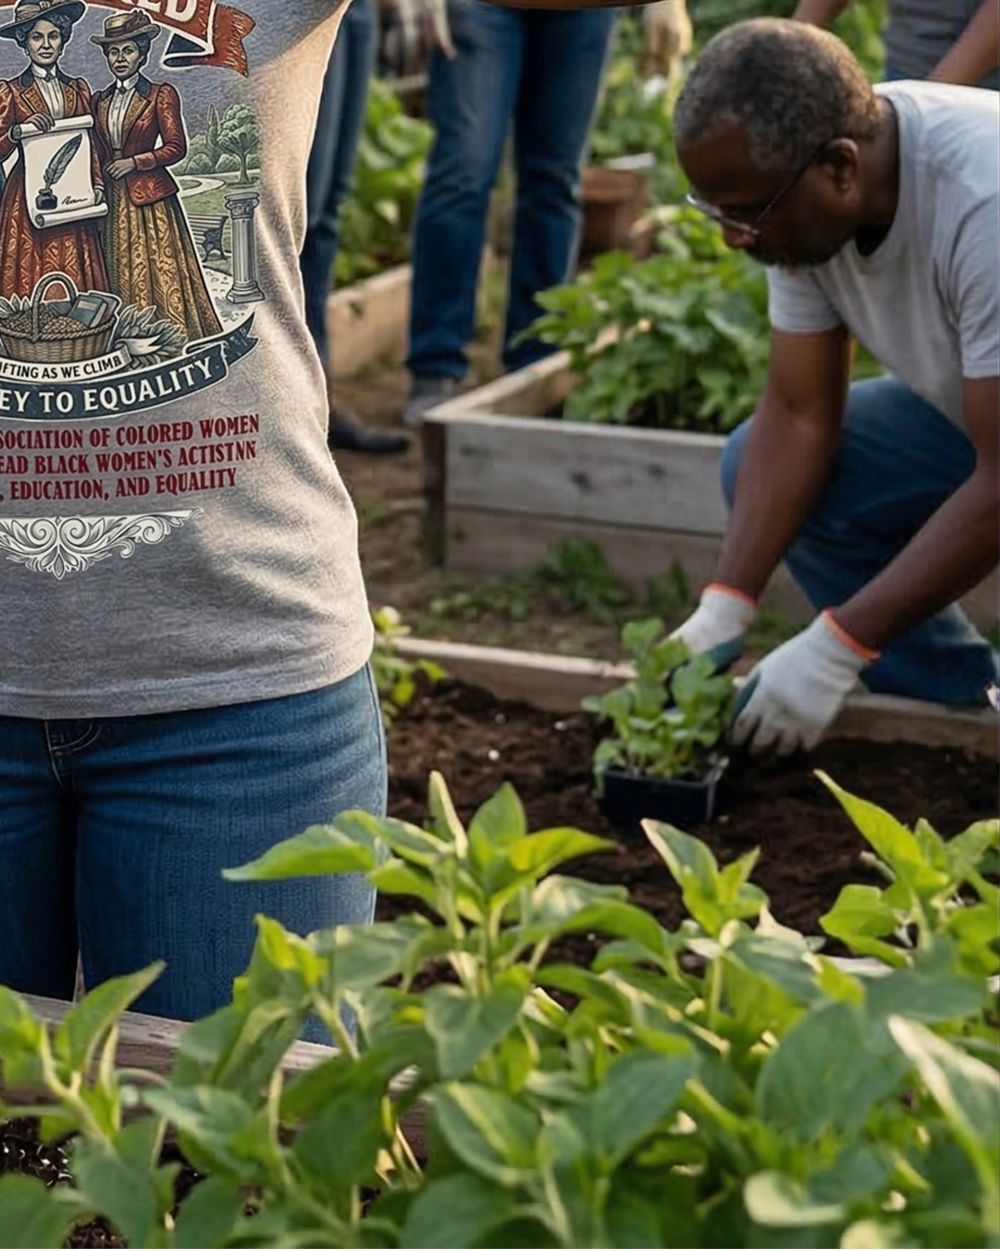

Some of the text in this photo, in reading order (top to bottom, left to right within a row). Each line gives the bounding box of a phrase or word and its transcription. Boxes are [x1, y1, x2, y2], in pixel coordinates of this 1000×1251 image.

[41, 367, 58, 379] AS
[60, 365, 81, 378] WE
[83, 355, 122, 376] CLIMB
[39, 391, 74, 414] TO
[83, 356, 212, 412] EQUALITY
[89, 428, 111, 448] OF
[116, 421, 194, 447] COLORED
[199, 413, 260, 440] WOMEN
[34, 454, 90, 475] BLACK
[95, 448, 173, 474] WOMEN'S
[10, 478, 110, 501] EDUCATION,
[115, 475, 151, 498] AND
[155, 467, 237, 496] EQUALITY
